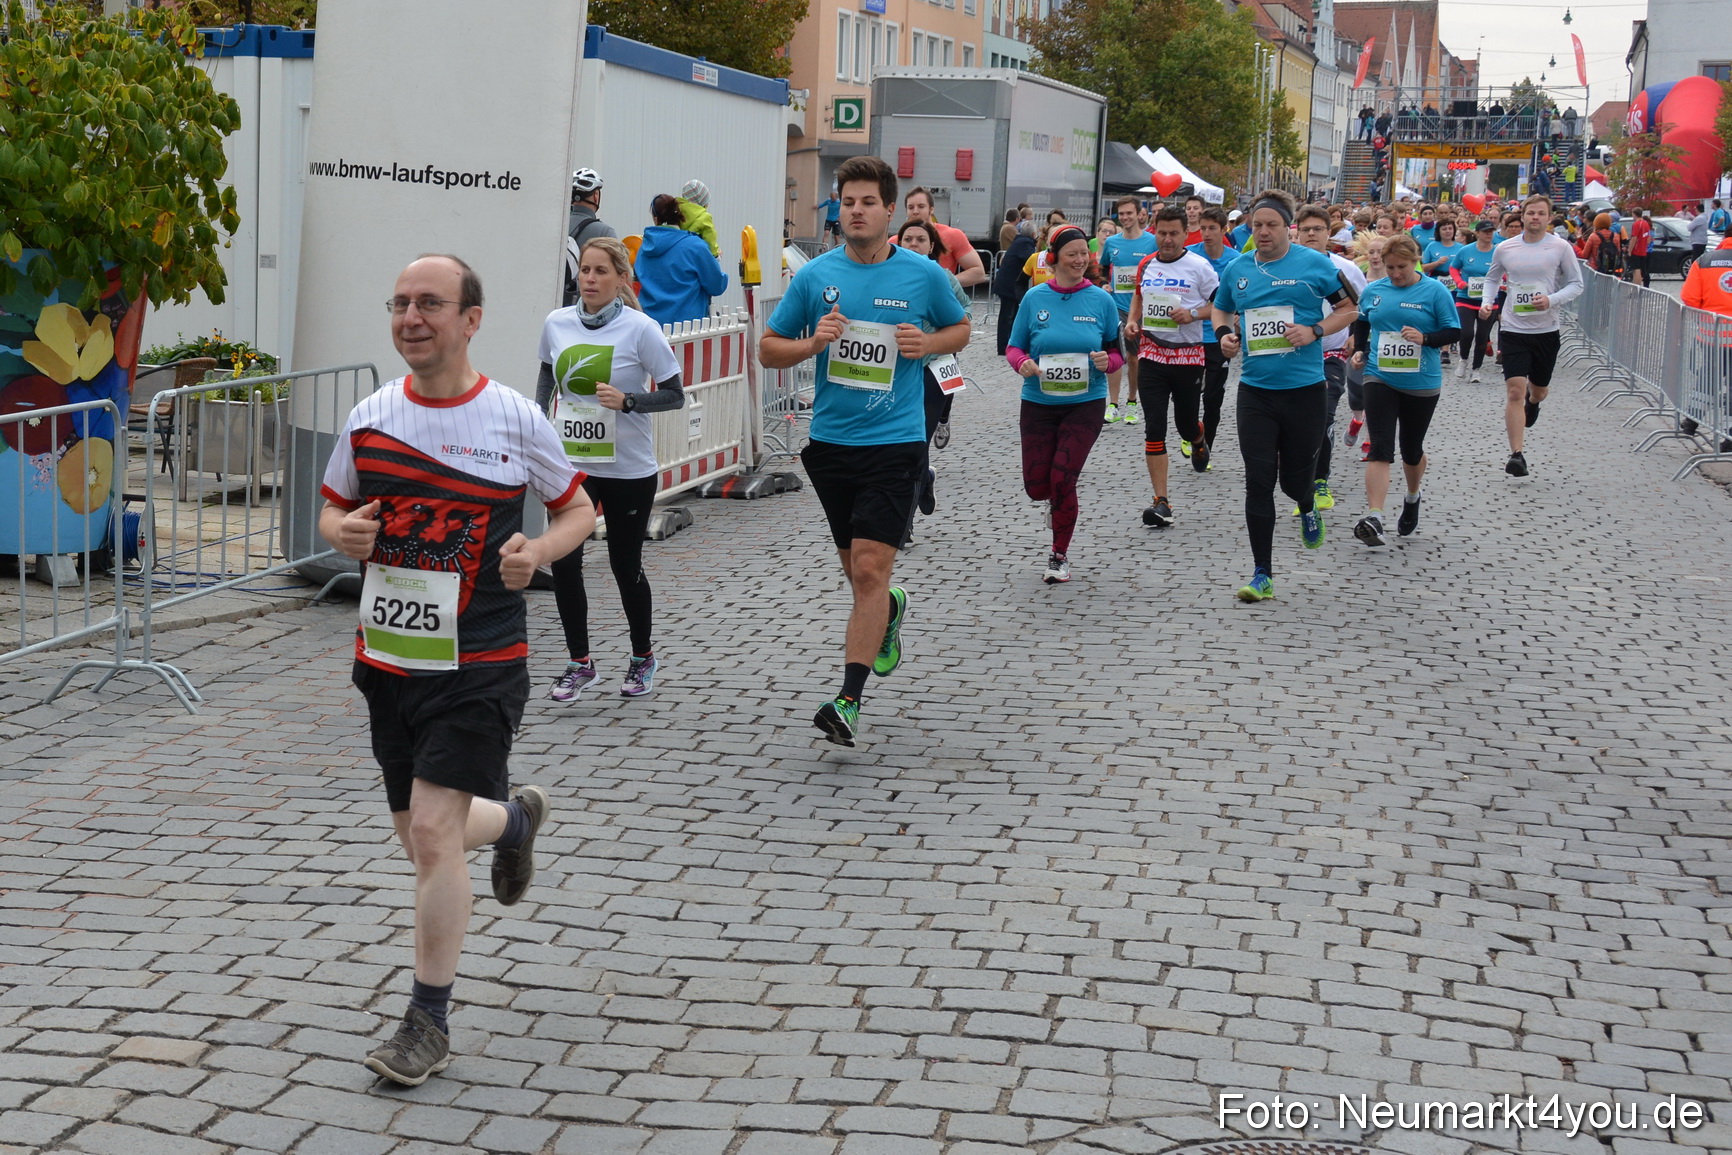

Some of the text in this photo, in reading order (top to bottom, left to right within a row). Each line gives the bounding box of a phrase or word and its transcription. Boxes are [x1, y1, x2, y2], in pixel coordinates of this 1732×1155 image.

[839, 103, 860, 125] D
[1071, 130, 1097, 170] BOCK
[1449, 146, 1480, 157] ZIEL
[309, 158, 521, 190] www.bmw-laufsport.de
[873, 298, 909, 309] BOCK
[1400, 302, 1422, 310] BOCK
[1073, 315, 1096, 323] BOCK
[1251, 320, 1286, 337] 5236
[838, 338, 887, 364] 5090
[1383, 344, 1414, 357] 5165
[848, 366, 870, 377] Tobias
[1046, 367, 1081, 380] 5235
[563, 419, 606, 440] 5080
[441, 444, 500, 461] NEUMARKT
[575, 445, 591, 453] Julia
[393, 576, 428, 589] BOCK
[372, 595, 440, 632] 5225
